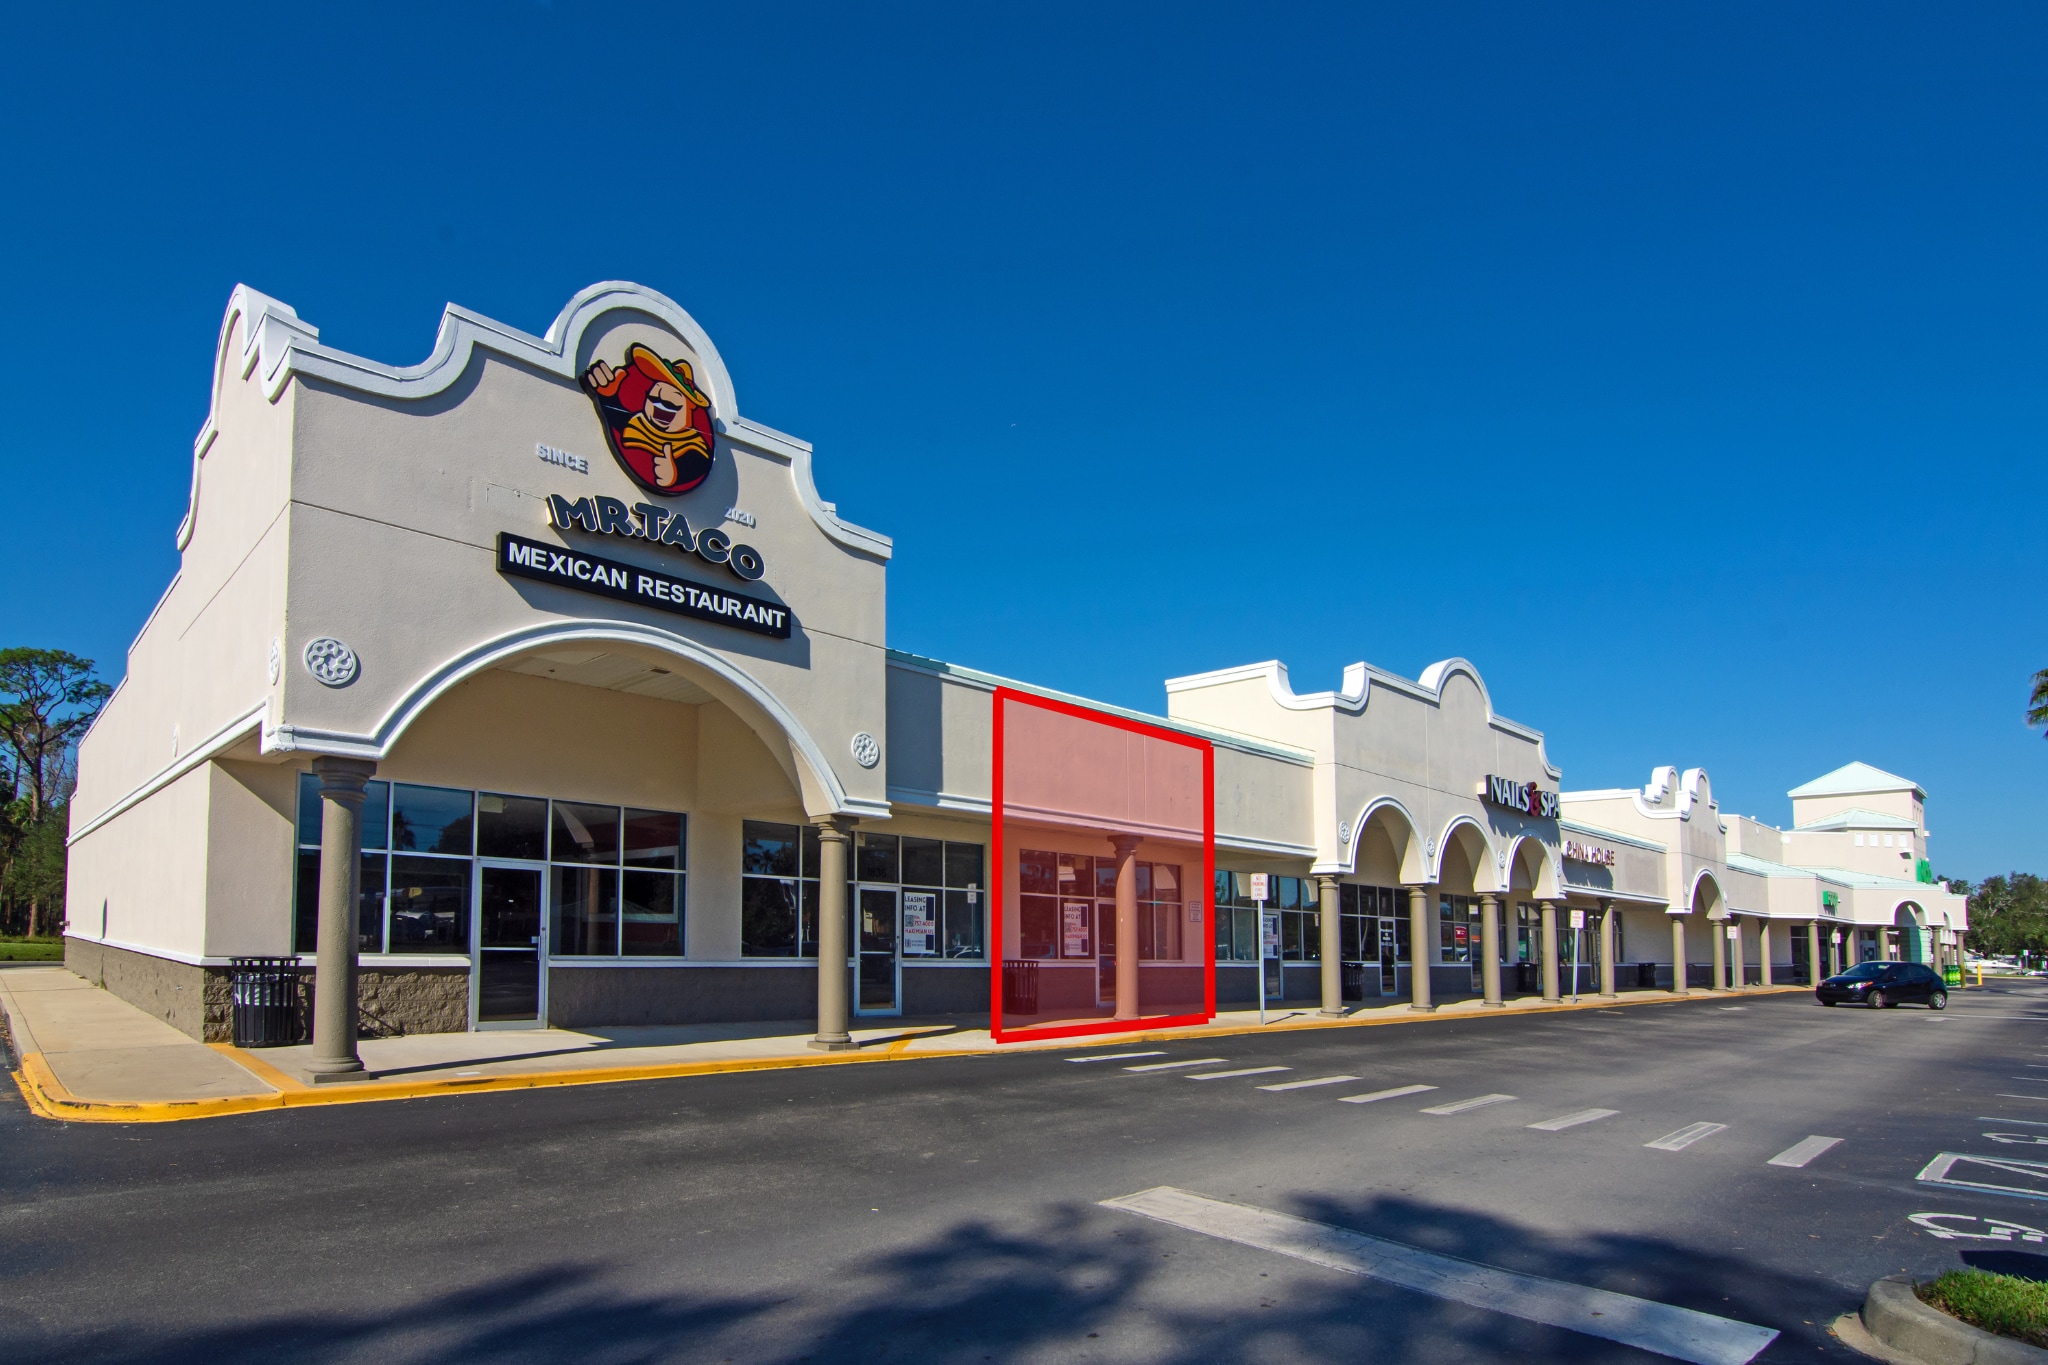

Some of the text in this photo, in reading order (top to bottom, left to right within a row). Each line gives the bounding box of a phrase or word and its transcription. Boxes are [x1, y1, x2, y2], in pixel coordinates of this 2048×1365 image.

[536, 443, 588, 474] SINCE
[724, 506, 756, 528] 2020
[546, 494, 766, 581] MR.TACO
[508, 542, 786, 629] MEXICAN RESTAURANT
[1567, 840, 1589, 860] CHINA
[904, 895, 926, 903] LEASING
[904, 904, 918, 912] INFO
